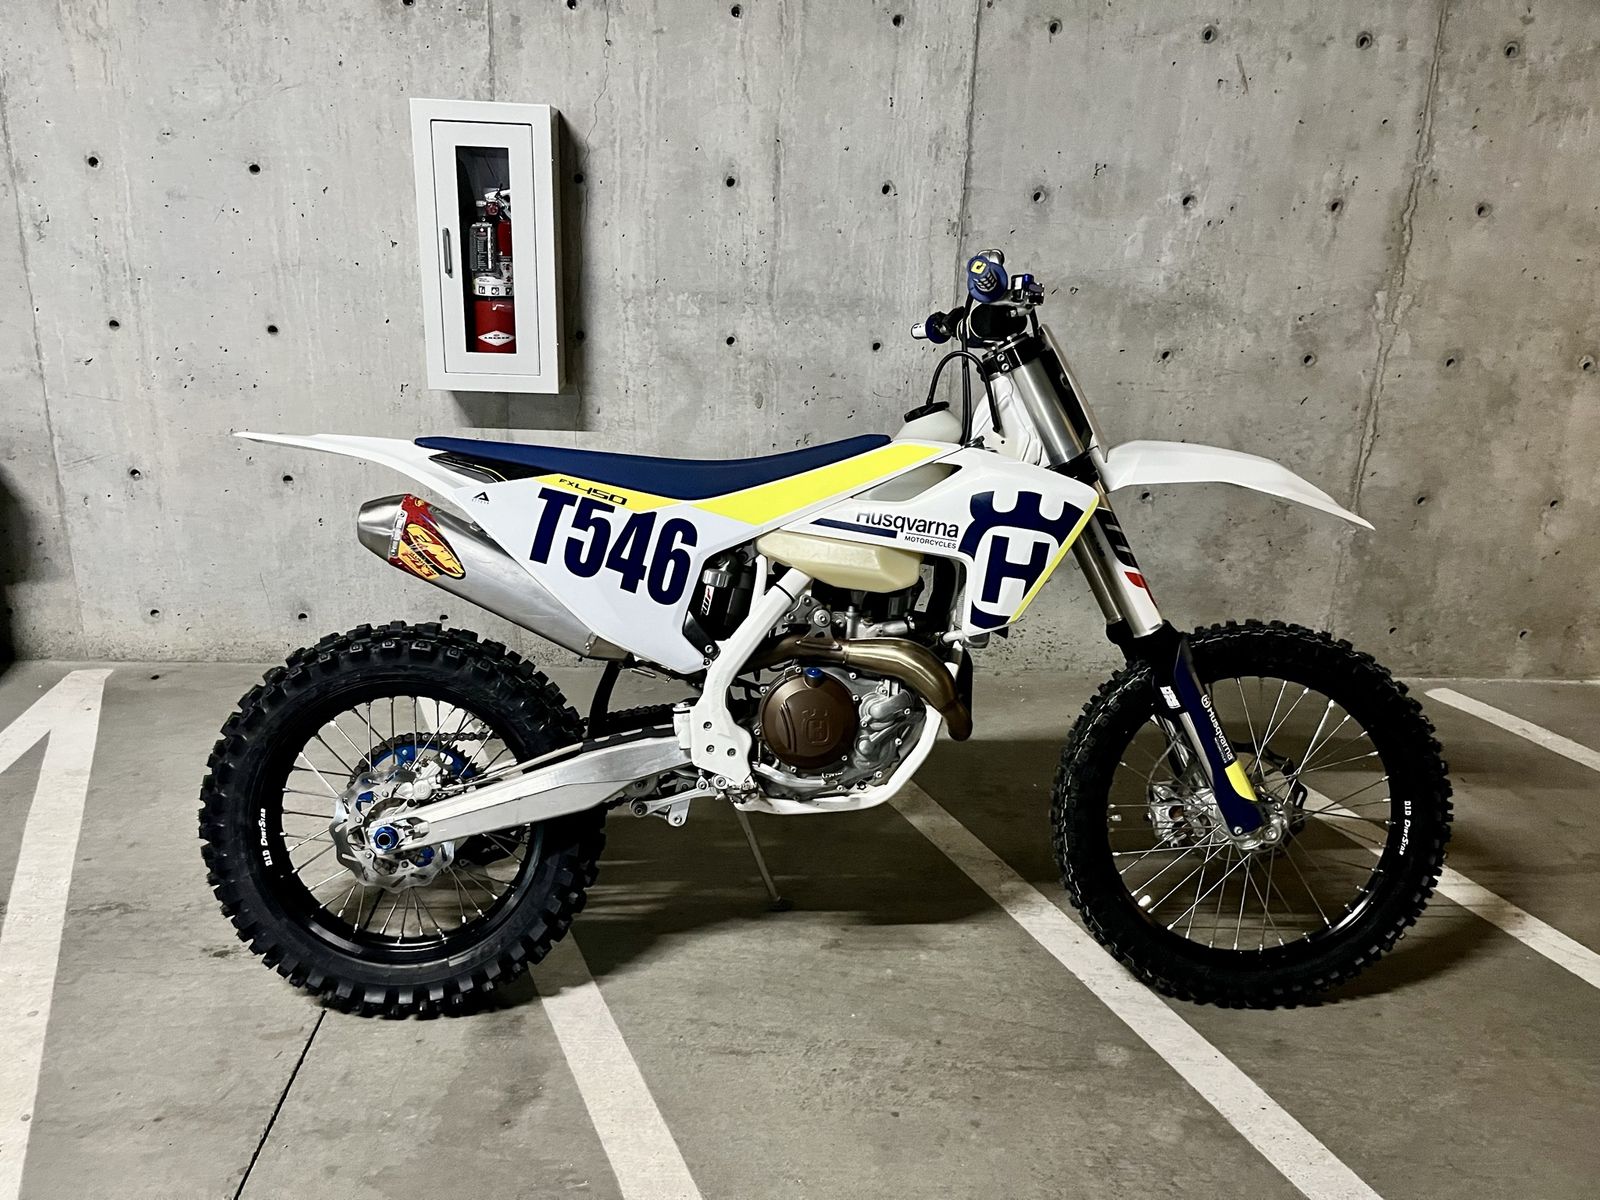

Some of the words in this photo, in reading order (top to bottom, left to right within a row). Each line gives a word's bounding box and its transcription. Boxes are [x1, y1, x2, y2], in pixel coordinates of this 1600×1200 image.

[406, 523, 465, 577] FMF
[530, 488, 697, 605] T546
[904, 535, 957, 549] MOTORCYCLES
[1207, 707, 1235, 760] Husqvarna
[262, 850, 273, 866] DID
